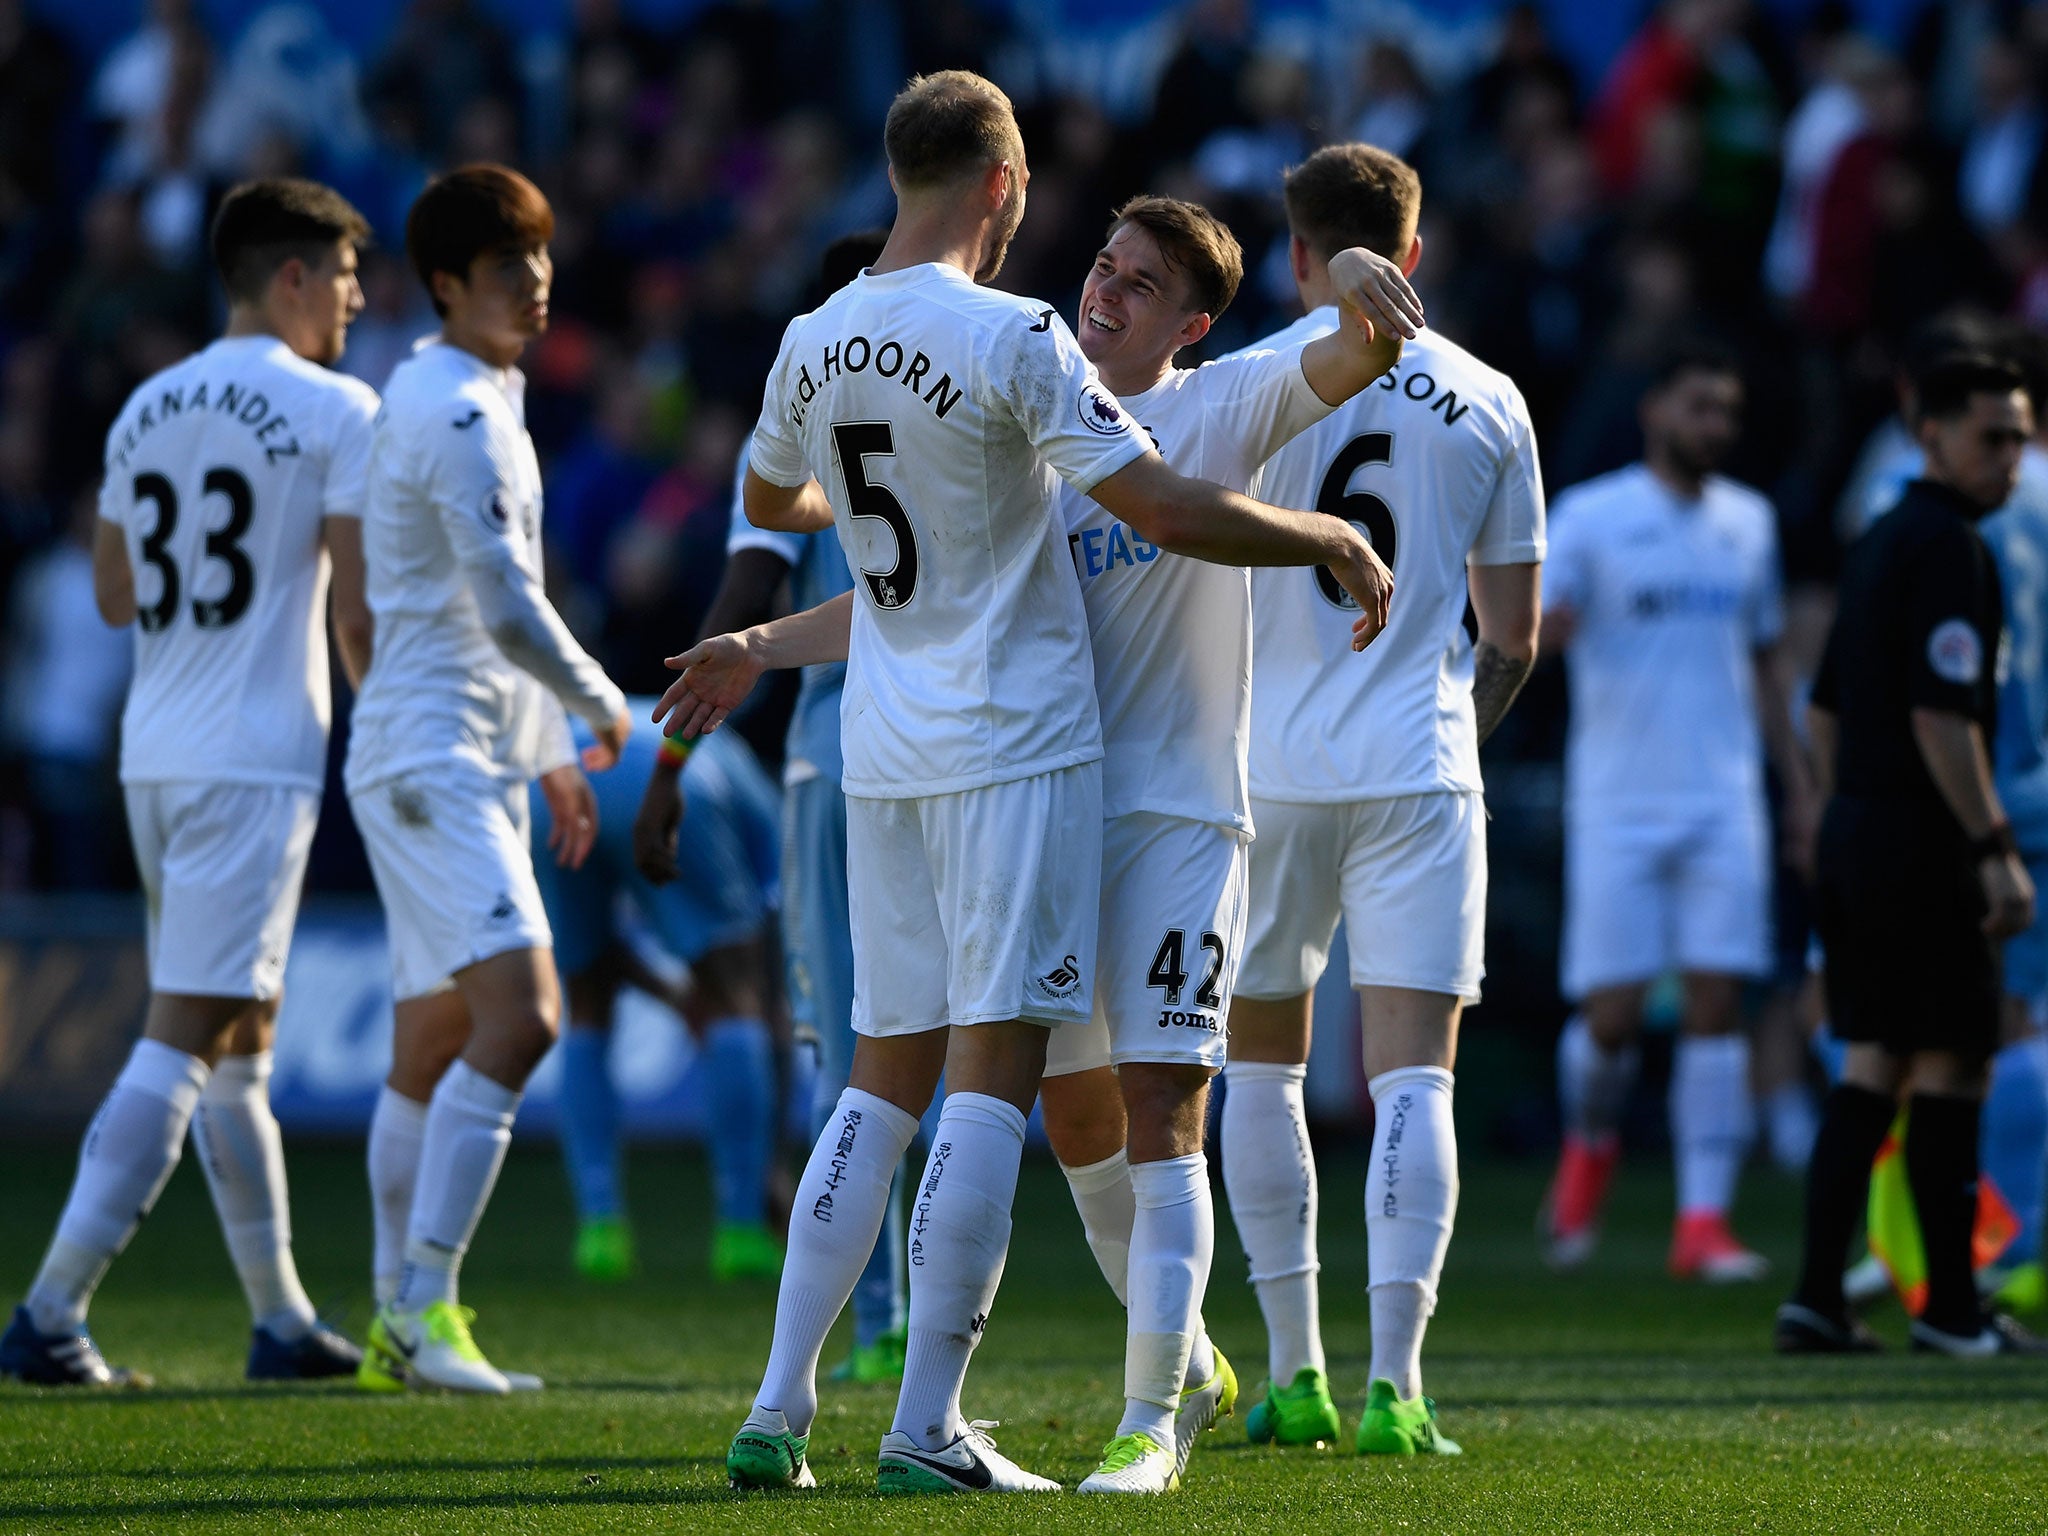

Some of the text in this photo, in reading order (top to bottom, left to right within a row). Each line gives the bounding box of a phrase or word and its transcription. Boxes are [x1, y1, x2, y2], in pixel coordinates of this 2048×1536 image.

[132, 466, 257, 634] 33
[830, 419, 922, 612] 5
[1311, 430, 1398, 612] 6
[1146, 928, 1222, 1011] 42
[735, 1437, 779, 1455] TIEMPO
